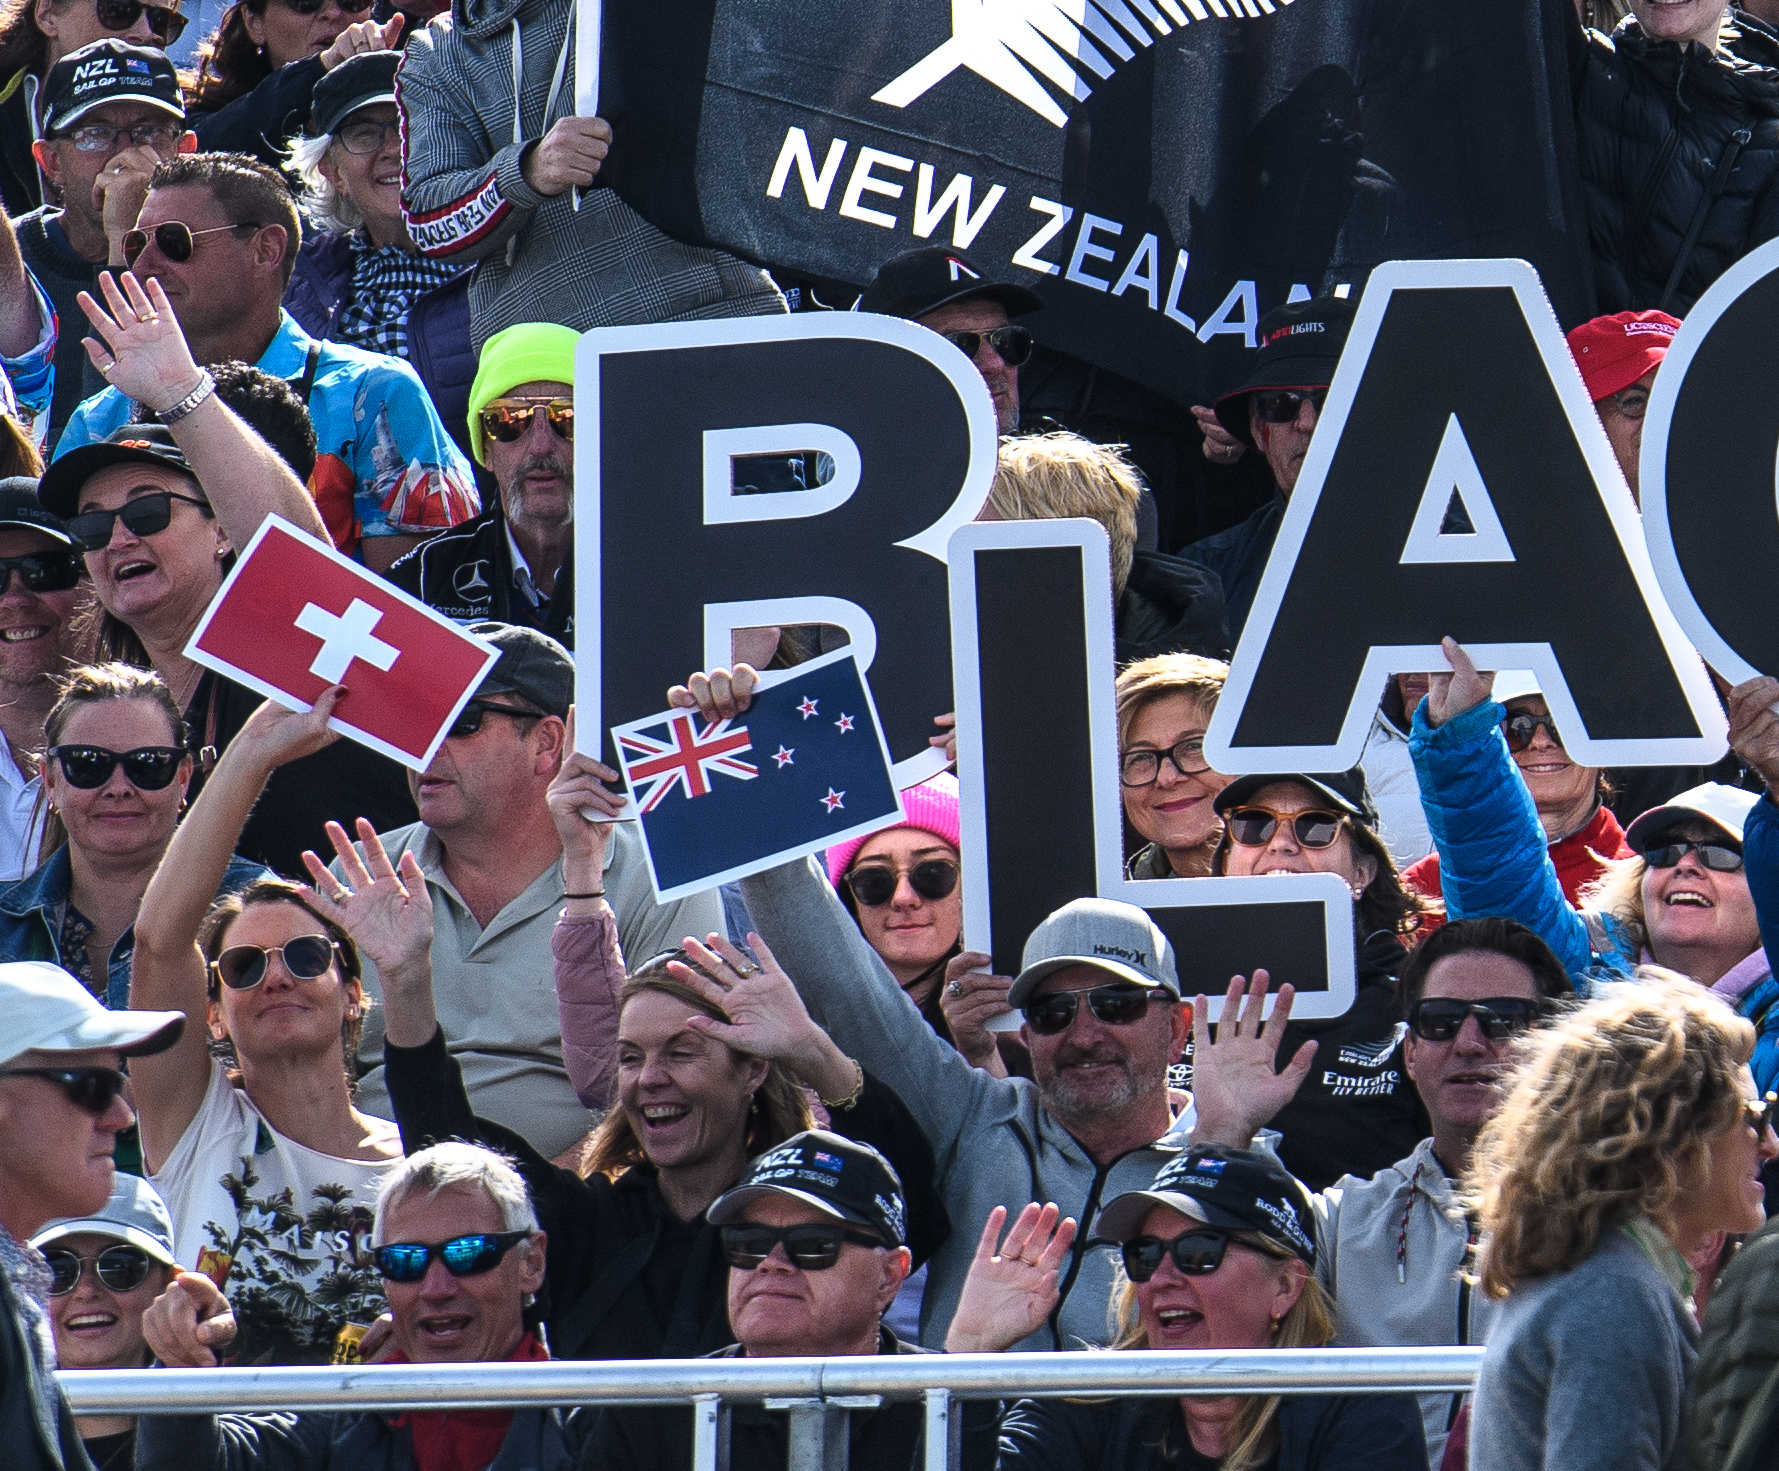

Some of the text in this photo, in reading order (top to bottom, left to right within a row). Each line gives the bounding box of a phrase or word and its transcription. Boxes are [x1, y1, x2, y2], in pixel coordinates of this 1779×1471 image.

[73, 58, 119, 83] NZL
[765, 125, 1007, 250] NEW
[430, 605, 489, 616] ercedes
[1092, 943, 1135, 962] Hurley
[1322, 1070, 1400, 1088] Emirate
[755, 1148, 805, 1173] NZL
[1254, 1197, 1286, 1223] RODD
